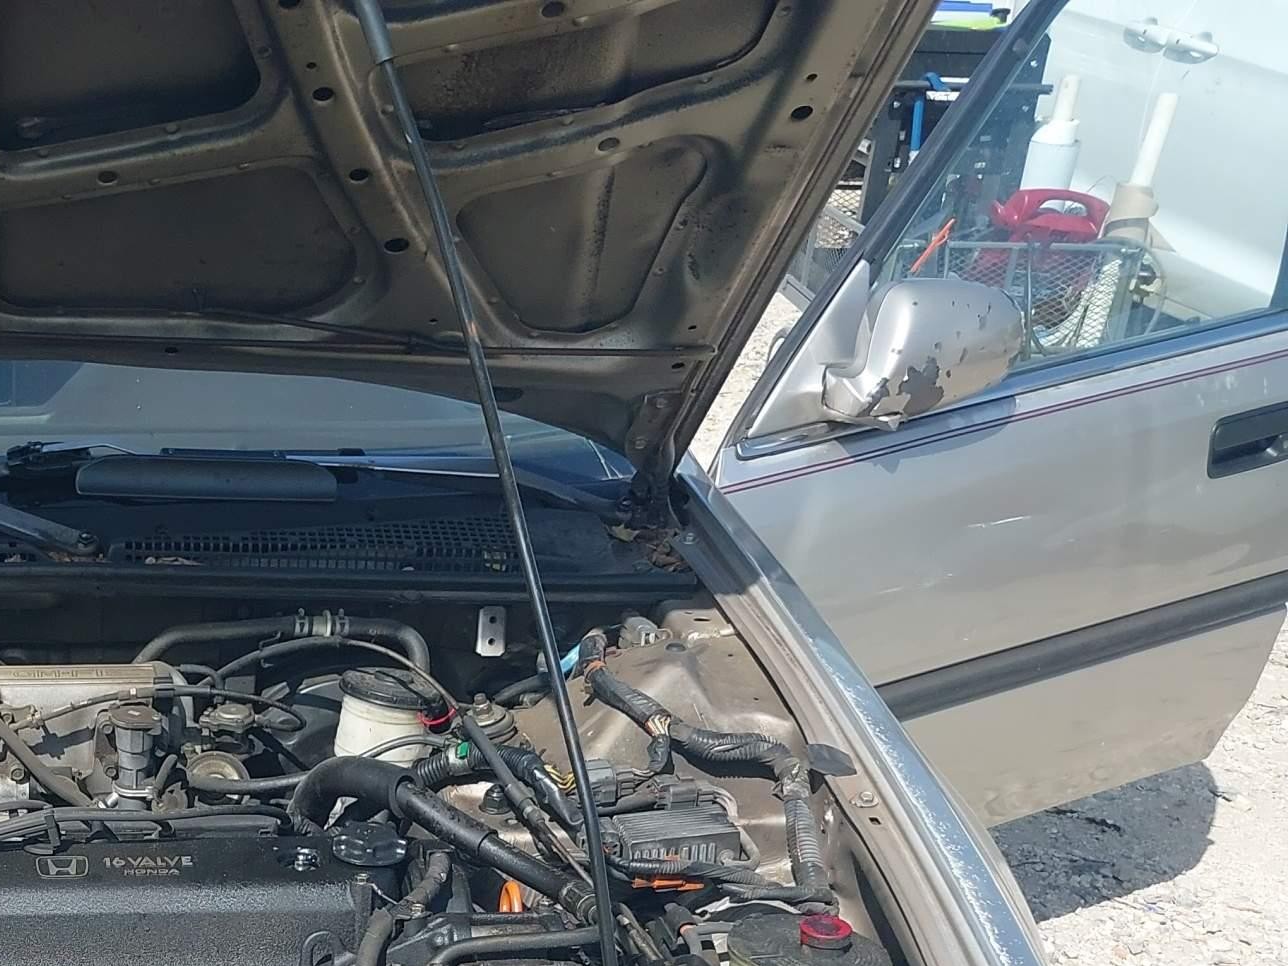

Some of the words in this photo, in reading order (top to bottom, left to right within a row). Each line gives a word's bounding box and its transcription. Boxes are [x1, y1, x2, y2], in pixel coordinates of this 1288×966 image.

[103, 857, 126, 868] 16
[127, 856, 193, 868] VALVE
[123, 868, 180, 876] HONDA
